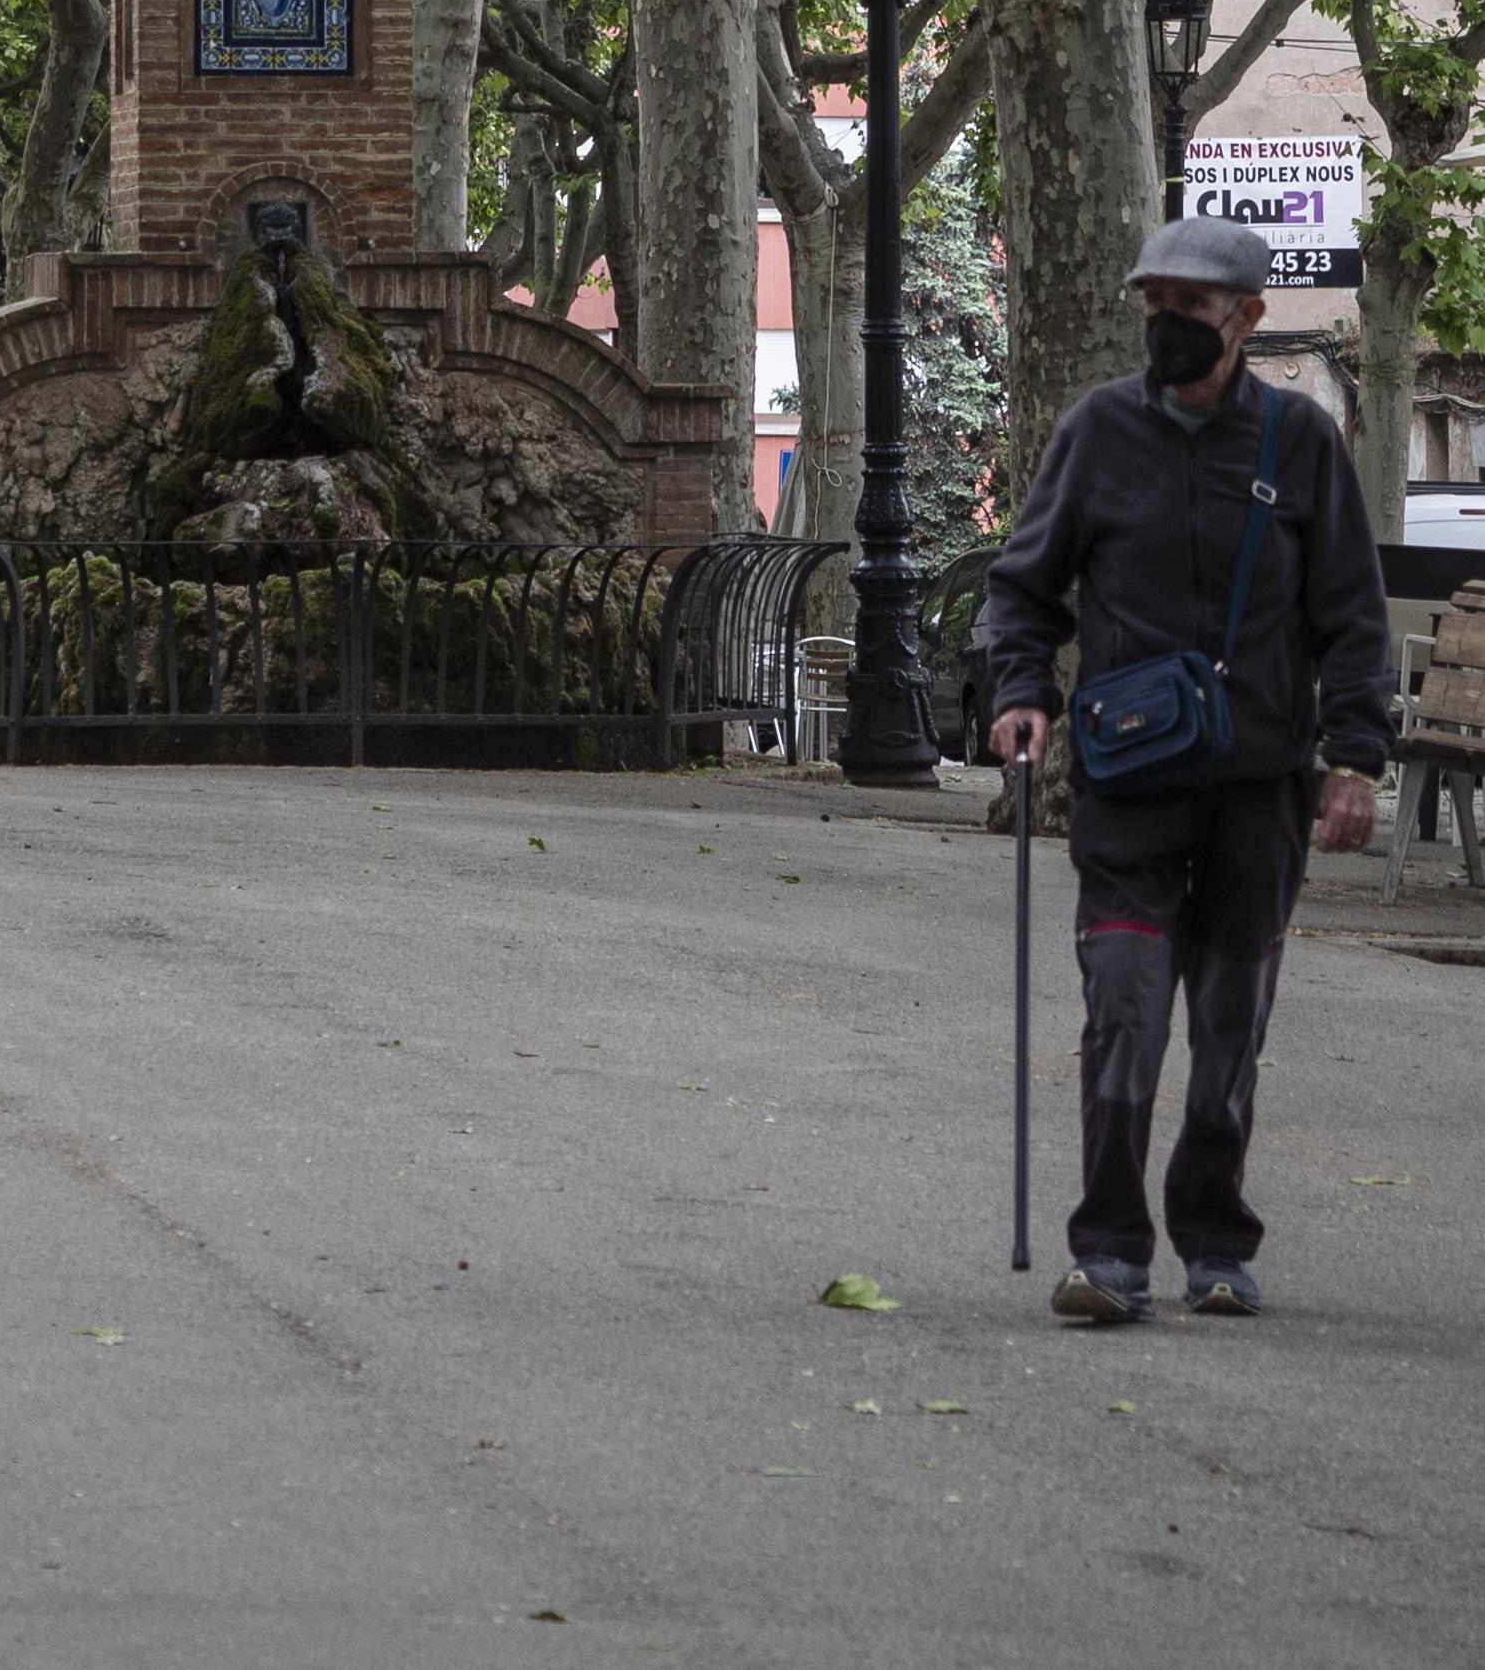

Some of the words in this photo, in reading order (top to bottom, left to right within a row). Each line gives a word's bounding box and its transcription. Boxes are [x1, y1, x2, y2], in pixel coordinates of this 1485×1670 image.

[1184, 143, 1224, 159] NDA
[1230, 143, 1252, 159] EN
[1223, 168, 1227, 183] I
[1233, 162, 1300, 183] DÚPLEX
[1306, 165, 1354, 182] NOUS
[1196, 189, 1324, 224] Clau21
[1271, 251, 1298, 272] 45
[1305, 251, 1332, 272] 23
